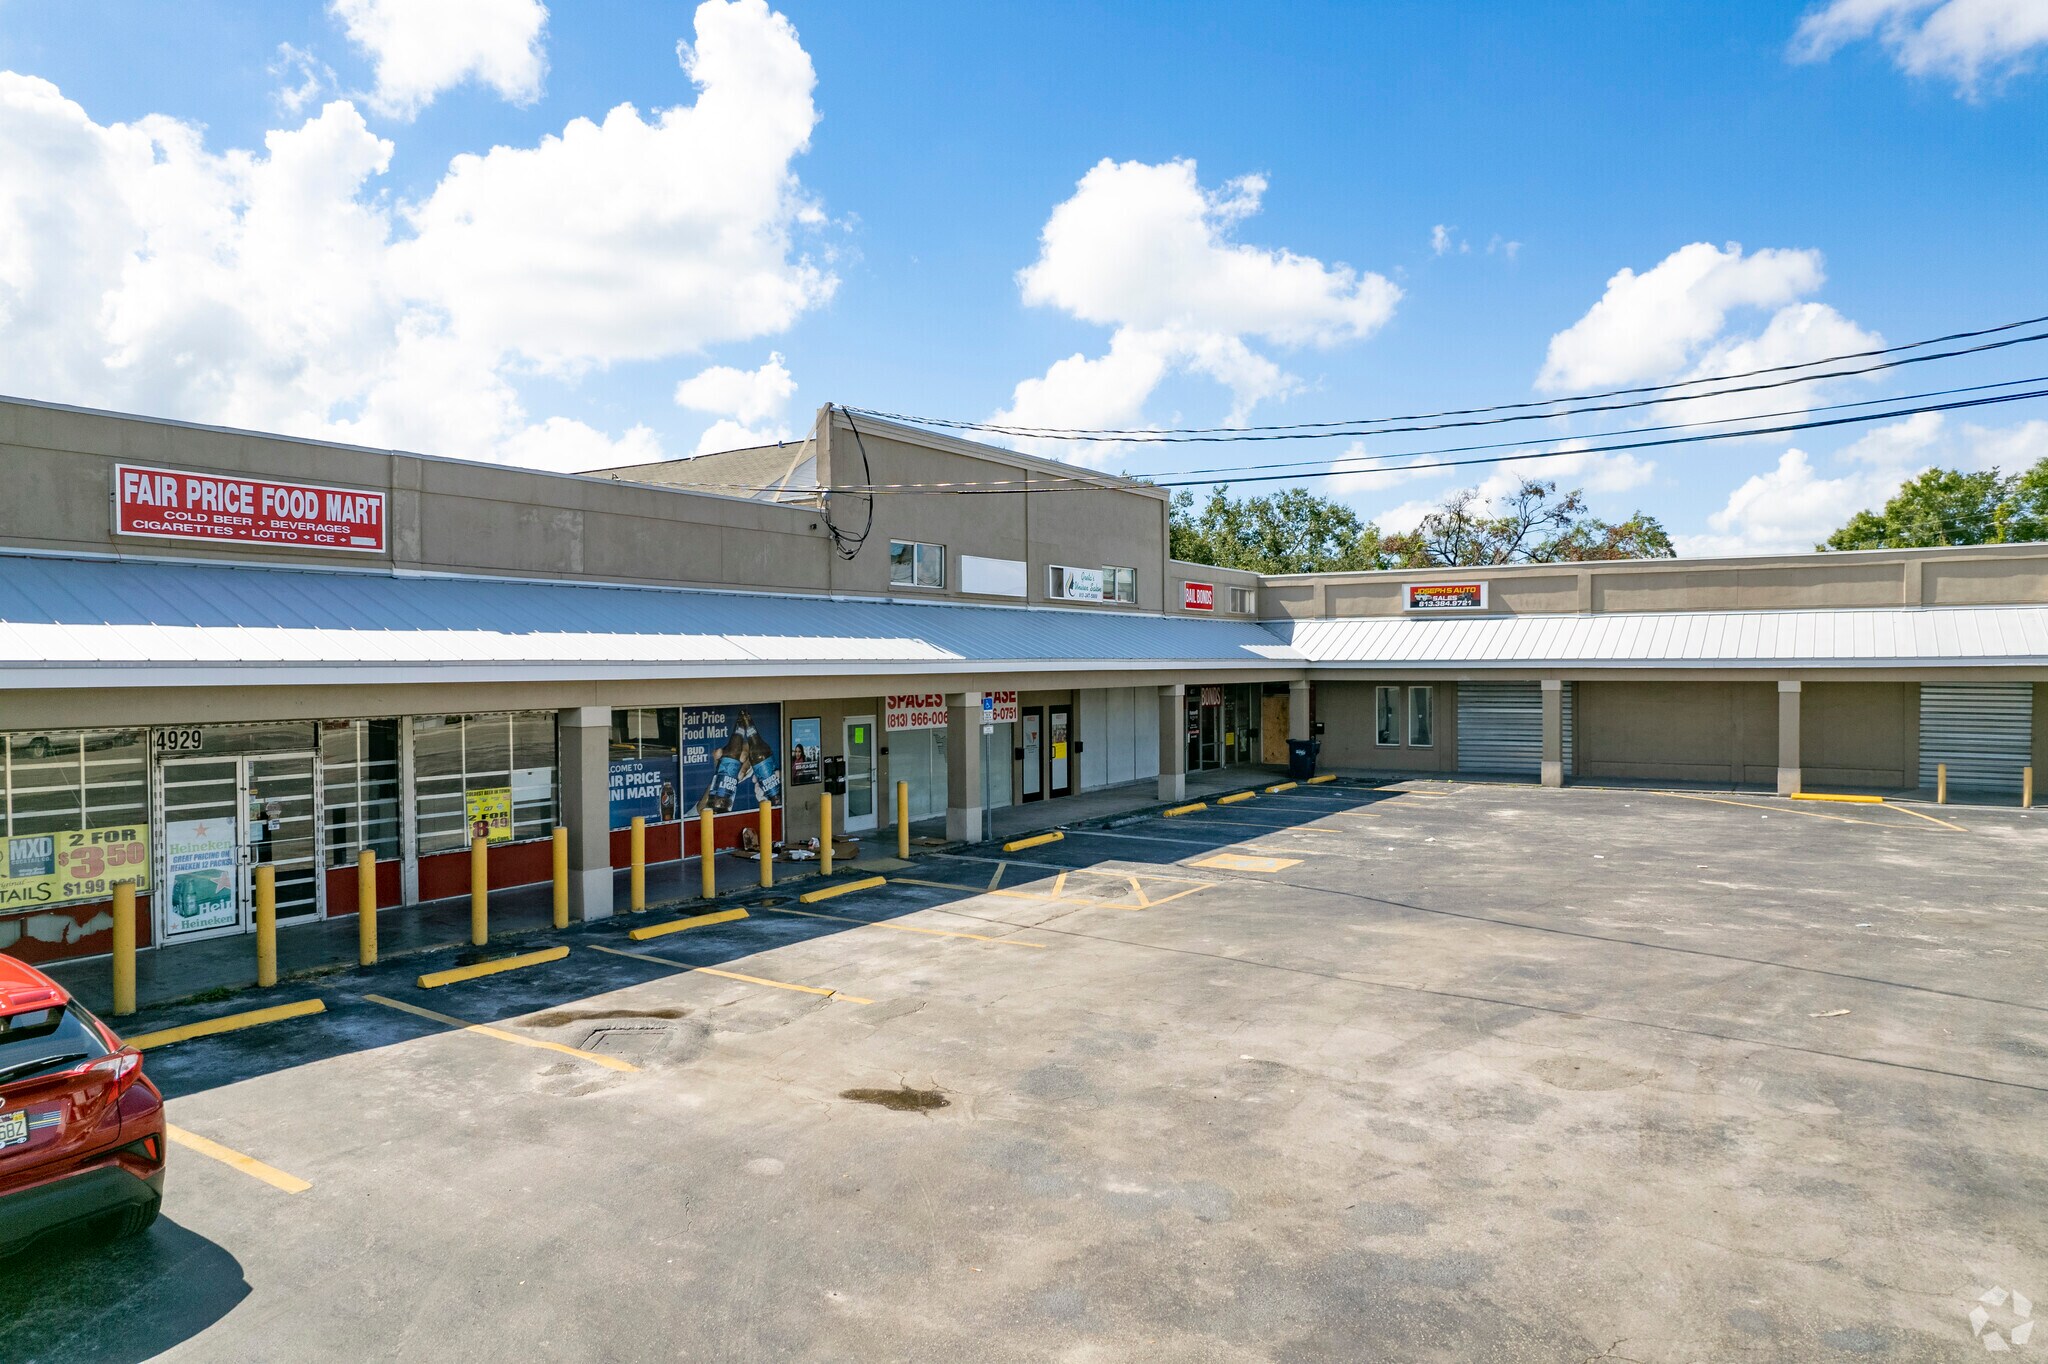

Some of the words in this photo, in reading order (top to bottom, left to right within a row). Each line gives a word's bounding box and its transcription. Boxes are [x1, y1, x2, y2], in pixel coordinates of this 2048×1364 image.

[124, 472, 178, 507] FAIR
[187, 479, 254, 515] PRICE
[262, 487, 319, 521] FOOD
[326, 494, 380, 525] MART
[164, 511, 208, 522] COLD
[213, 515, 253, 526] BEER
[270, 520, 351, 534] BEVERAGES
[132, 519, 233, 536] CIGARETTES
[251, 529, 298, 541] LOTTO
[314, 533, 335, 543] ICE
[1185, 588, 1196, 604] BAIL
[1197, 589, 1213, 605] BONDS
[1414, 587, 1453, 595] JOSEPHS
[1453, 586, 1476, 594] AUTO
[887, 694, 943, 709] SPACES
[1201, 687, 1221, 706] BONDS
[682, 712, 700, 726] Fair
[702, 711, 725, 724] Price
[887, 714, 908, 728] (813)
[156, 730, 202, 751] 4929
[683, 726, 705, 740] Food
[706, 726, 728, 738] Mart
[687, 746, 705, 755] BUD
[683, 753, 708, 764] LIGHT
[609, 764, 632, 773] COME
[633, 763, 643, 771] TO
[625, 771, 661, 786] PRICE
[724, 775, 738, 785] BUD
[762, 774, 776, 785] BUD
[627, 785, 662, 800] MART
[719, 781, 737, 792] LIGH
[69, 834, 84, 847] 2
[91, 829, 136, 844] FOR
[10, 837, 53, 861] MXD
[169, 841, 232, 855] Heineken
[173, 854, 193, 863] GREAT
[194, 851, 220, 861] PRICING
[220, 850, 230, 859] ON
[170, 862, 200, 872] HEINEKEN
[201, 861, 209, 869] 12
[63, 879, 105, 897] $1.99
[181, 915, 233, 930] Heineken
